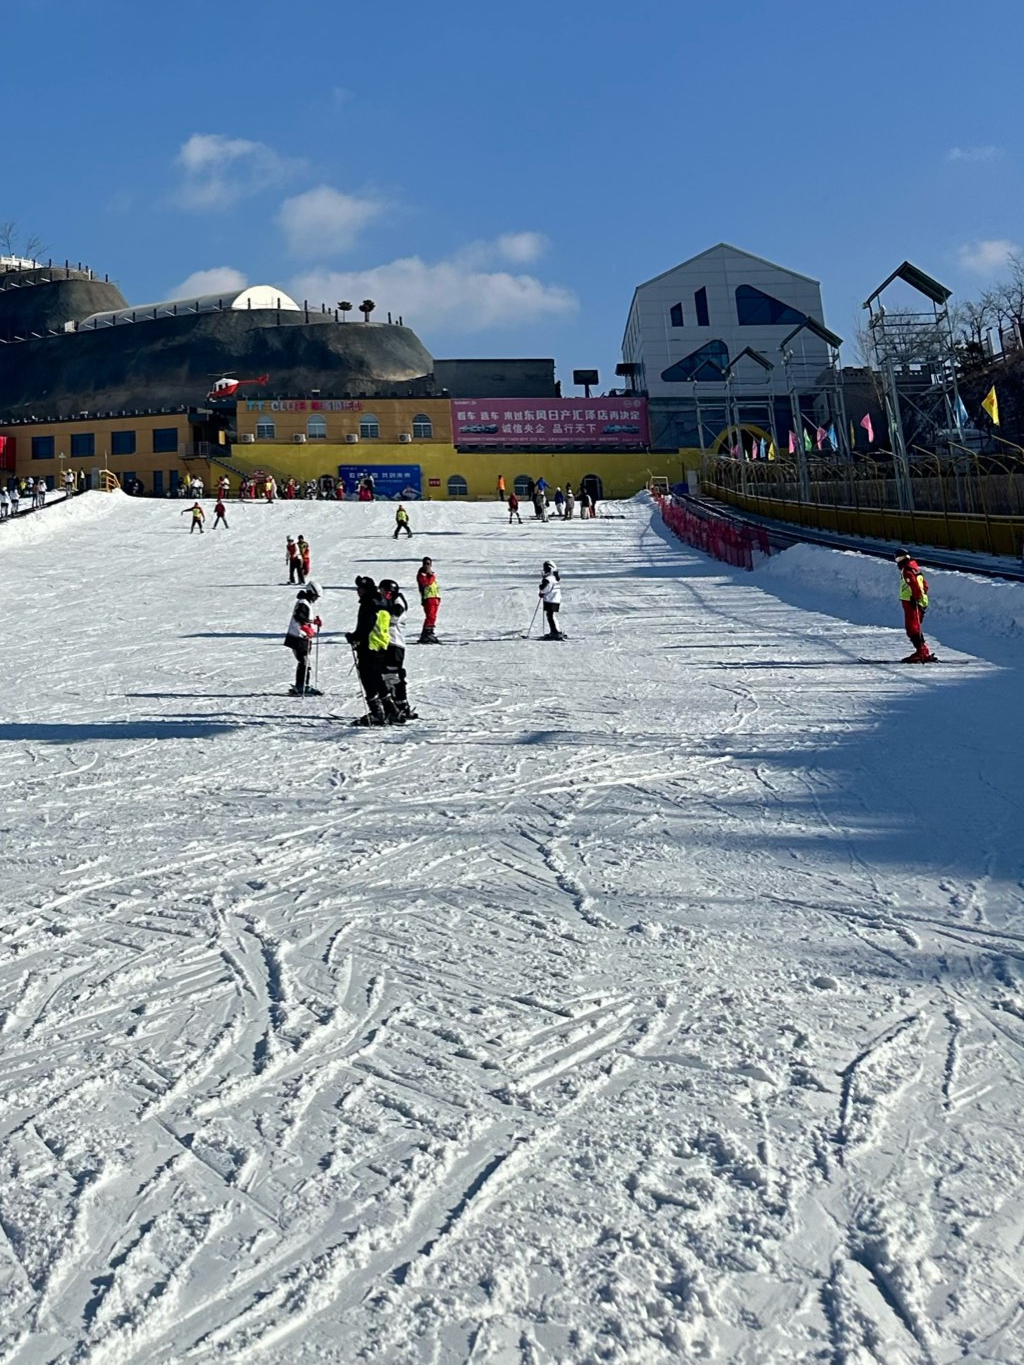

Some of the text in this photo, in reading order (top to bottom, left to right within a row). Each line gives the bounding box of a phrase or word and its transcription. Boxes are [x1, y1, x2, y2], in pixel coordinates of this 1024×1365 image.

[480, 411, 499, 421] 选车
[502, 423, 596, 434] 诚信央企 品行天下
